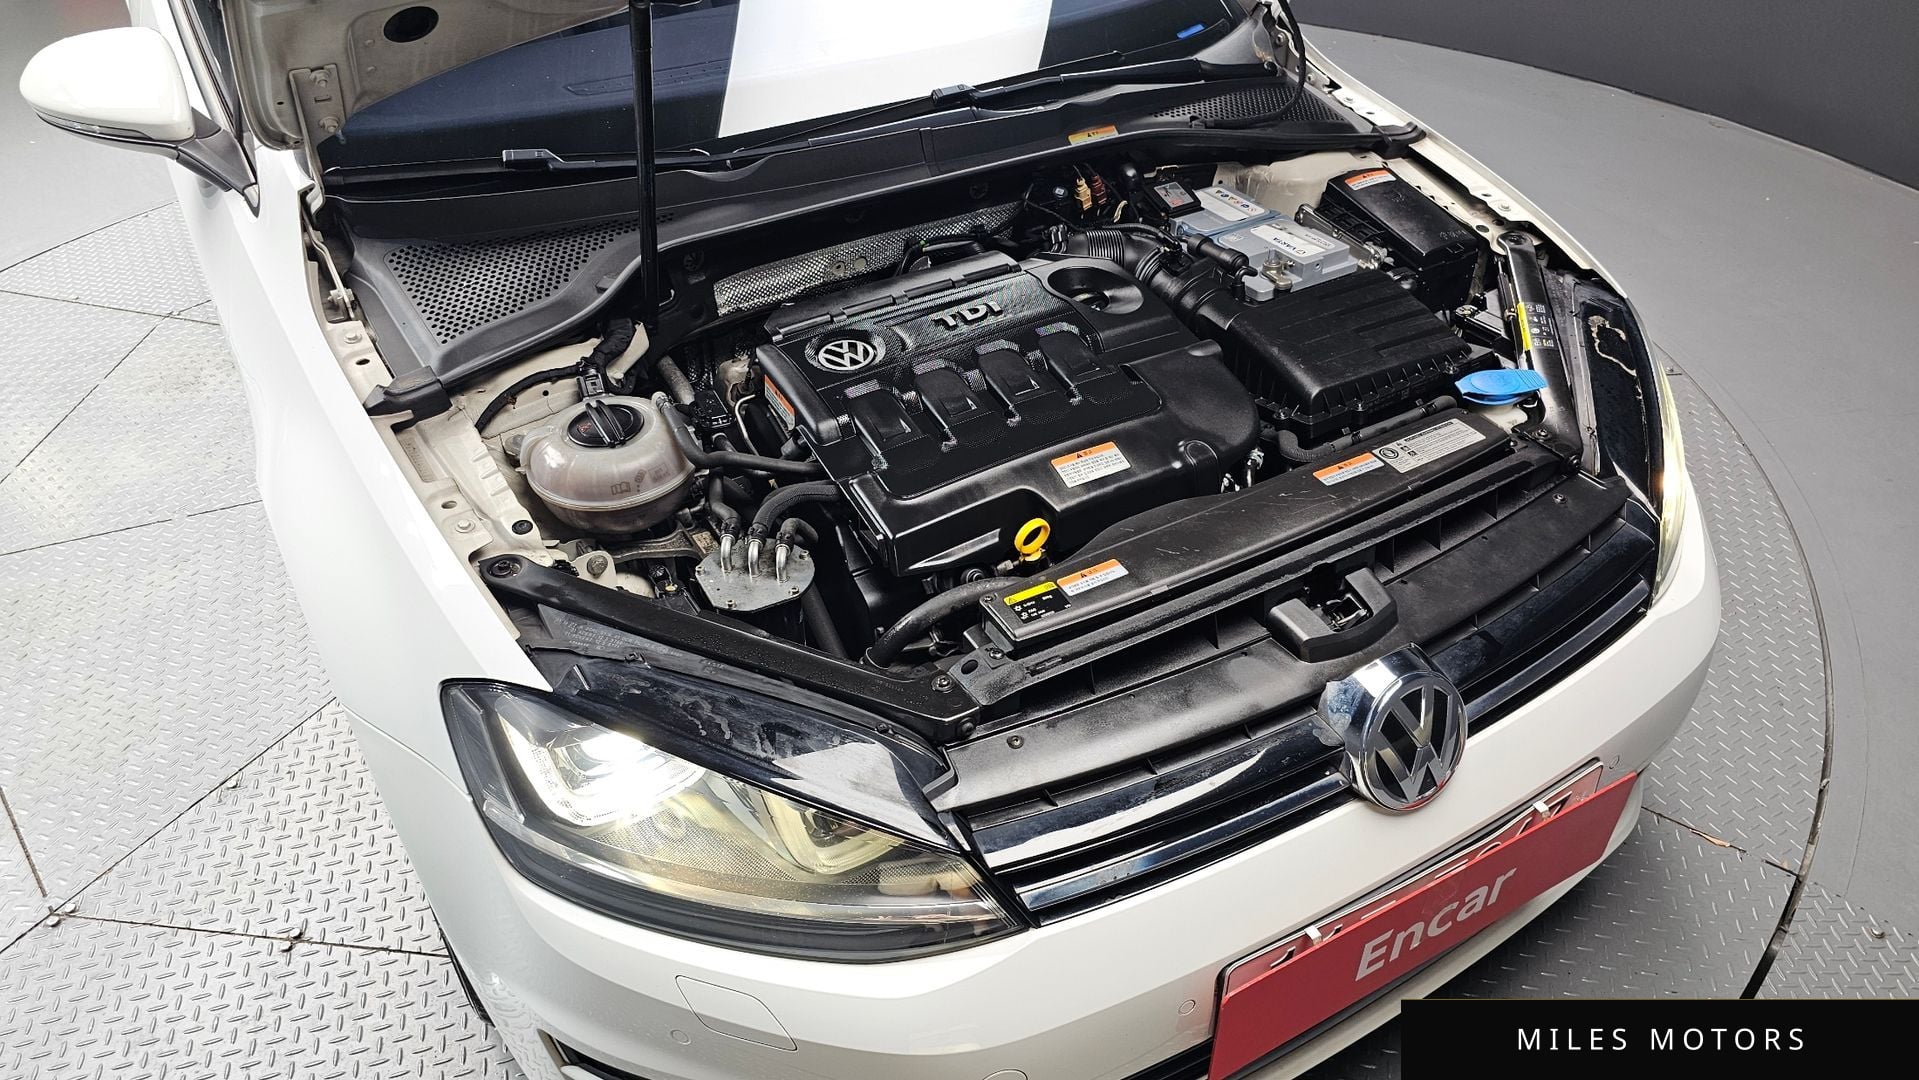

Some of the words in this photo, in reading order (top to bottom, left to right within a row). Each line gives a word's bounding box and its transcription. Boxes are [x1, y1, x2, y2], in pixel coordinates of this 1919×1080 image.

[934, 300, 1003, 329] TDI
[817, 339, 875, 371] VW
[1363, 670, 1468, 811] VW
[1355, 867, 1517, 981] Encar
